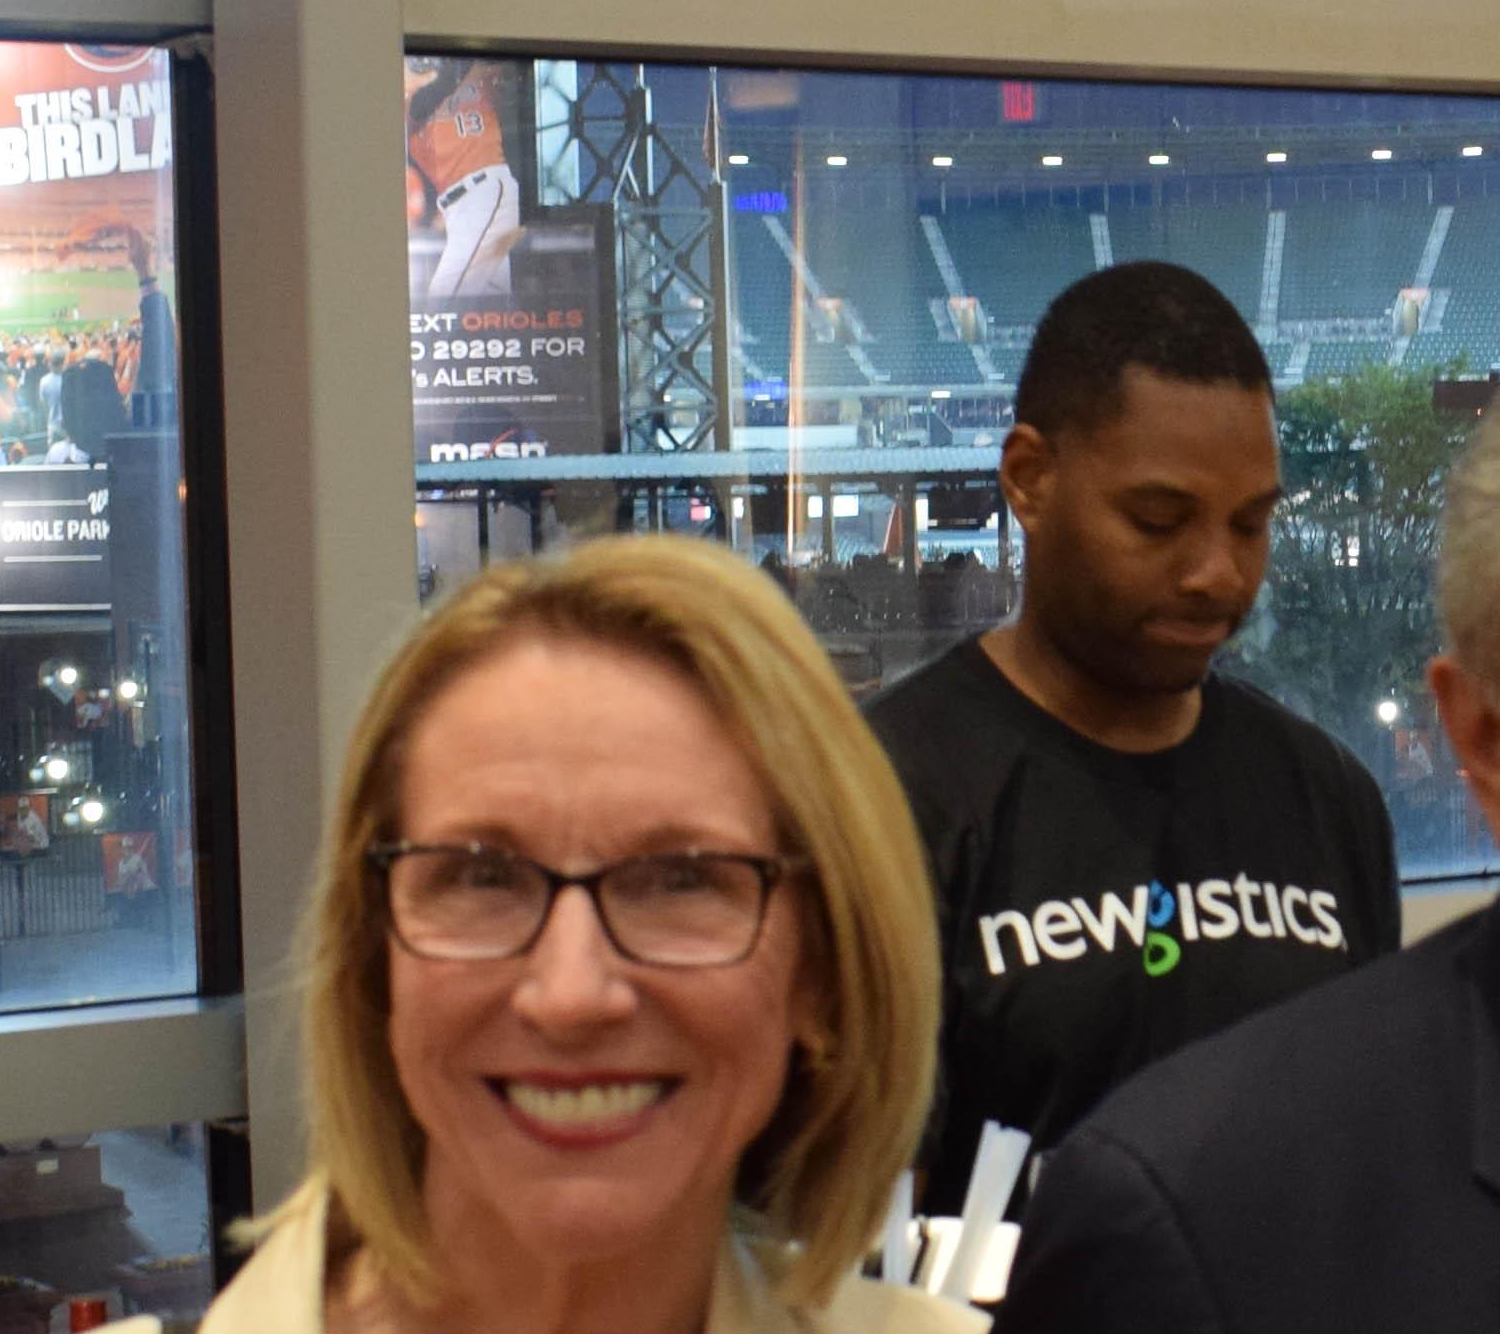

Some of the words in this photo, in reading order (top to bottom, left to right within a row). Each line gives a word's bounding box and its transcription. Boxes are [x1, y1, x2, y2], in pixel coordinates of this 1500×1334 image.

[15, 88, 94, 125] THIS
[454, 113, 485, 138] 13
[409, 312, 457, 333] EXT
[461, 308, 585, 331] ORIOLES
[433, 338, 521, 360] 29292
[531, 337, 585, 357] FOR
[432, 366, 538, 387] ALERTS.
[1, 519, 65, 542] ORIOLE
